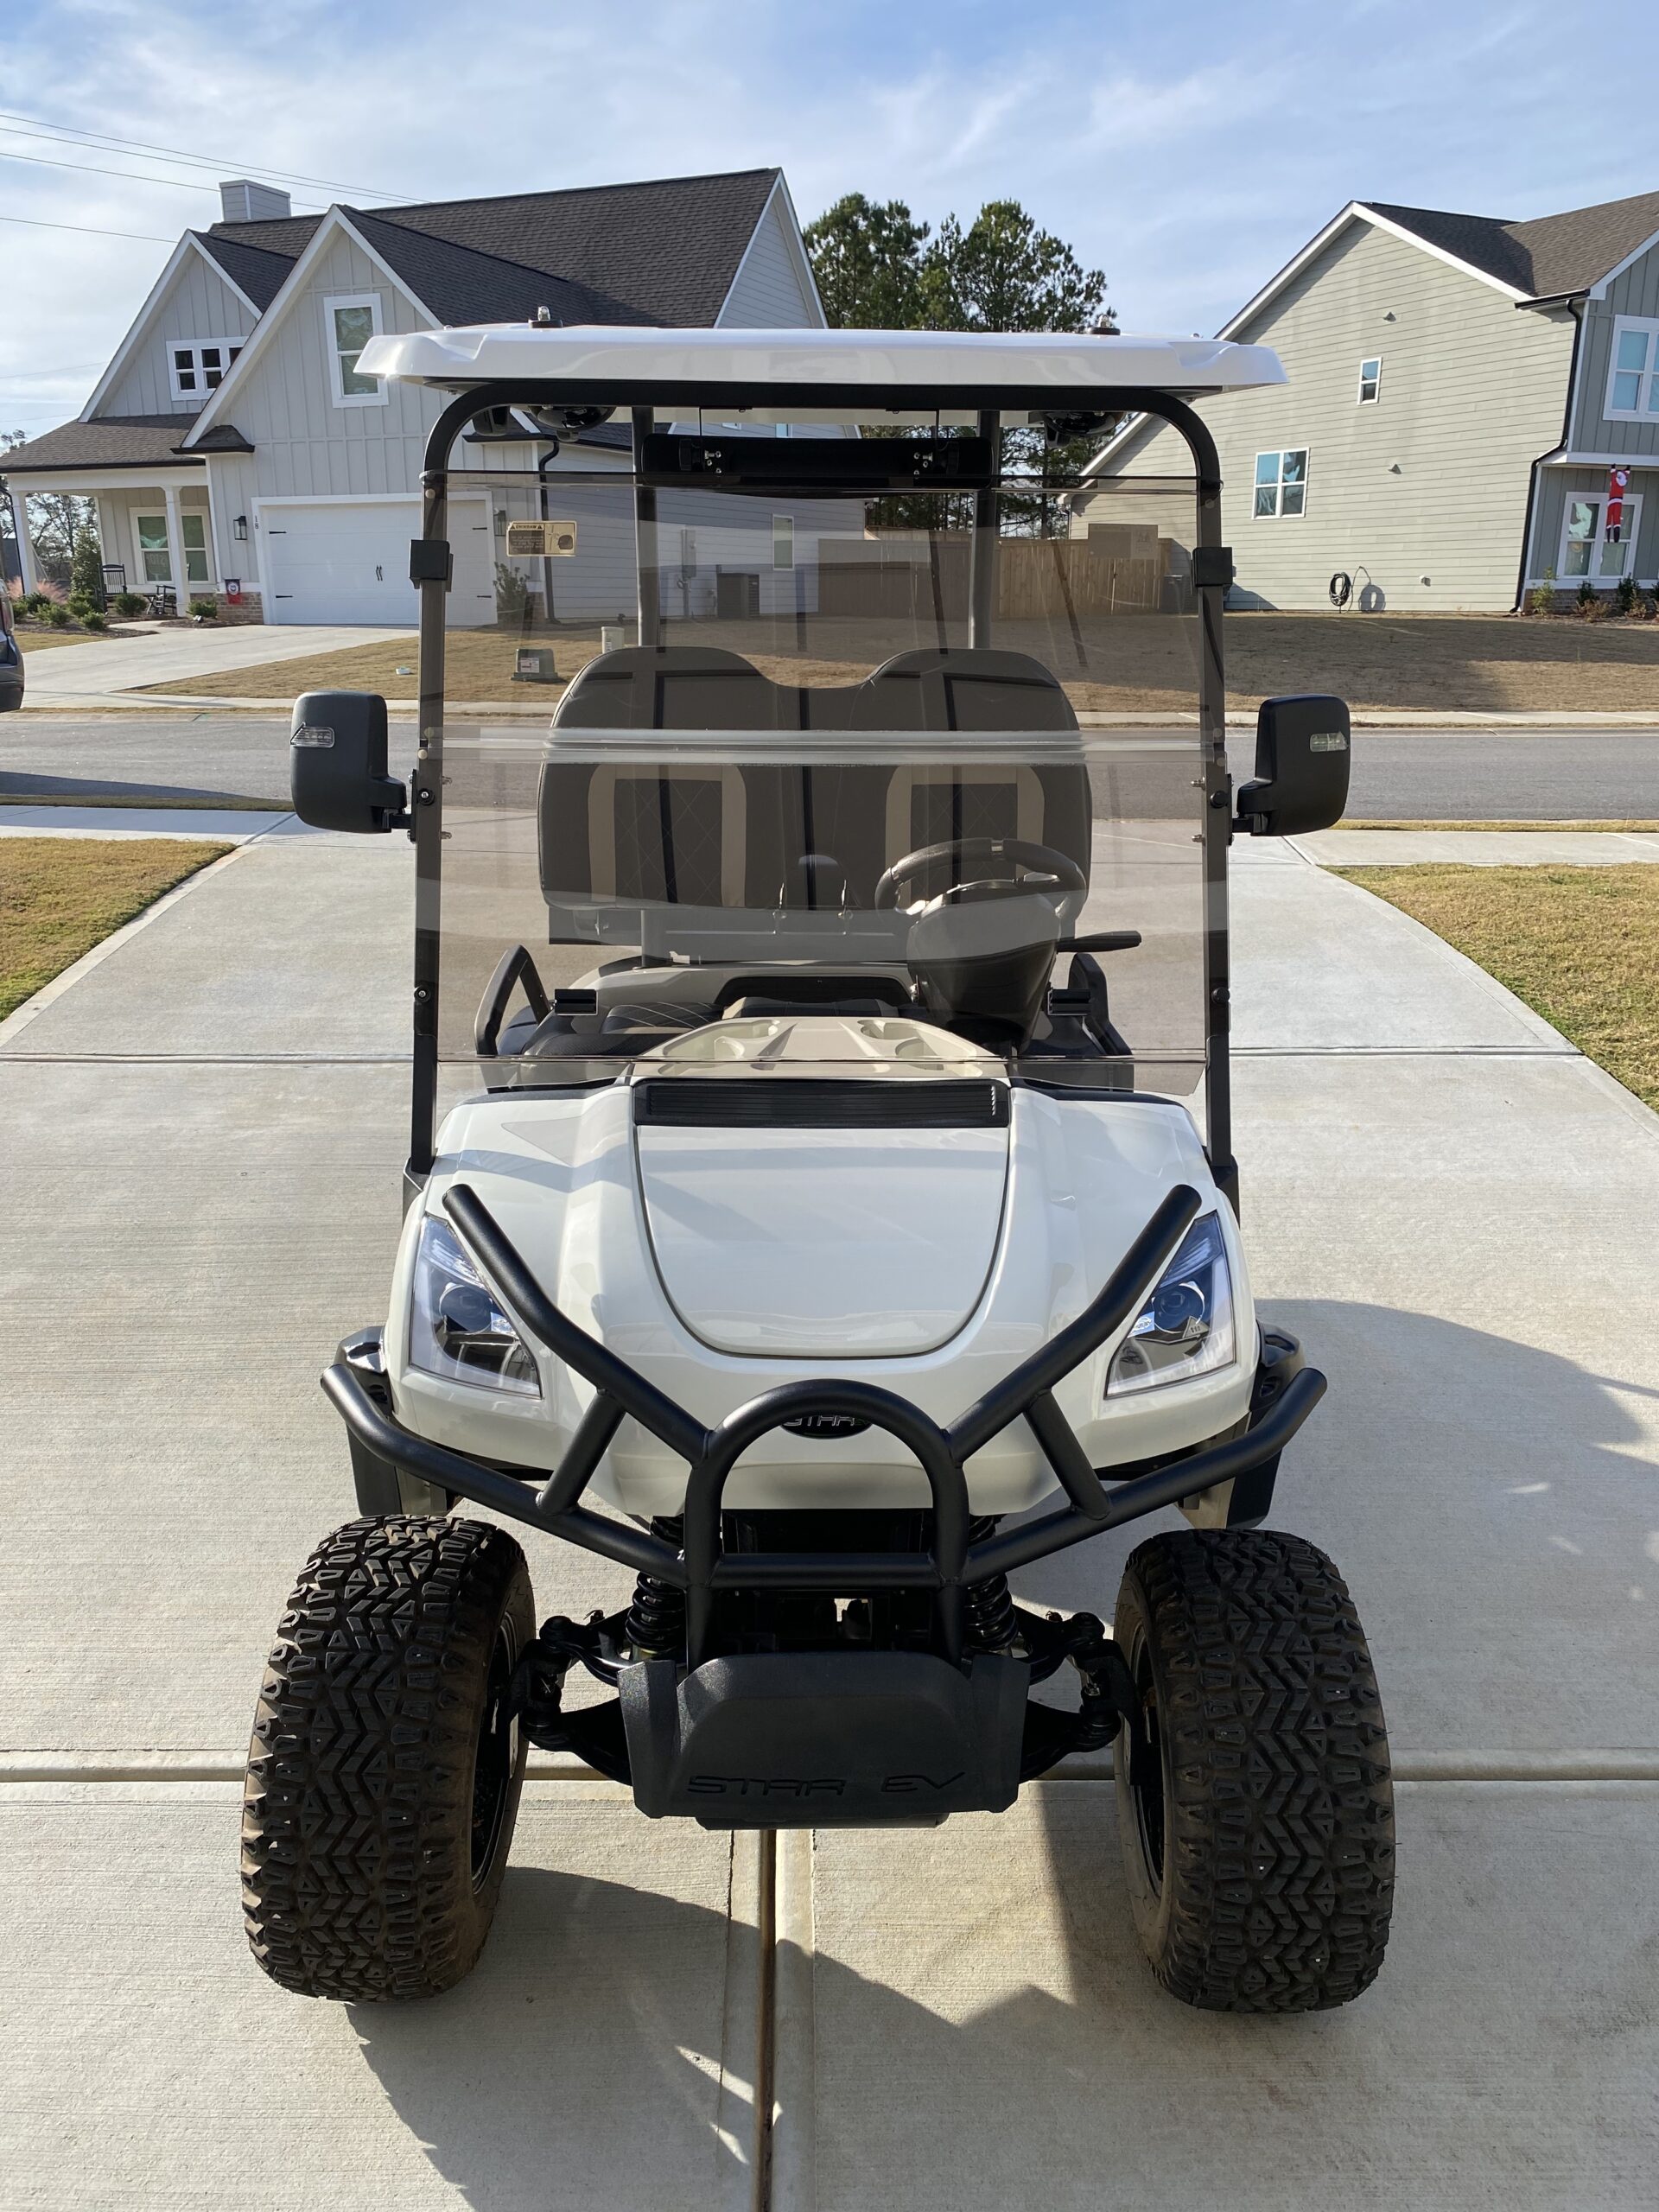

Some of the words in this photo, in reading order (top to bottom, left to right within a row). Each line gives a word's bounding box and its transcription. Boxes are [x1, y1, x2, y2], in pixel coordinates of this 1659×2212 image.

[254, 515, 259, 530] 18
[688, 1775, 847, 1796] STAR
[881, 1771, 965, 1793] EV
